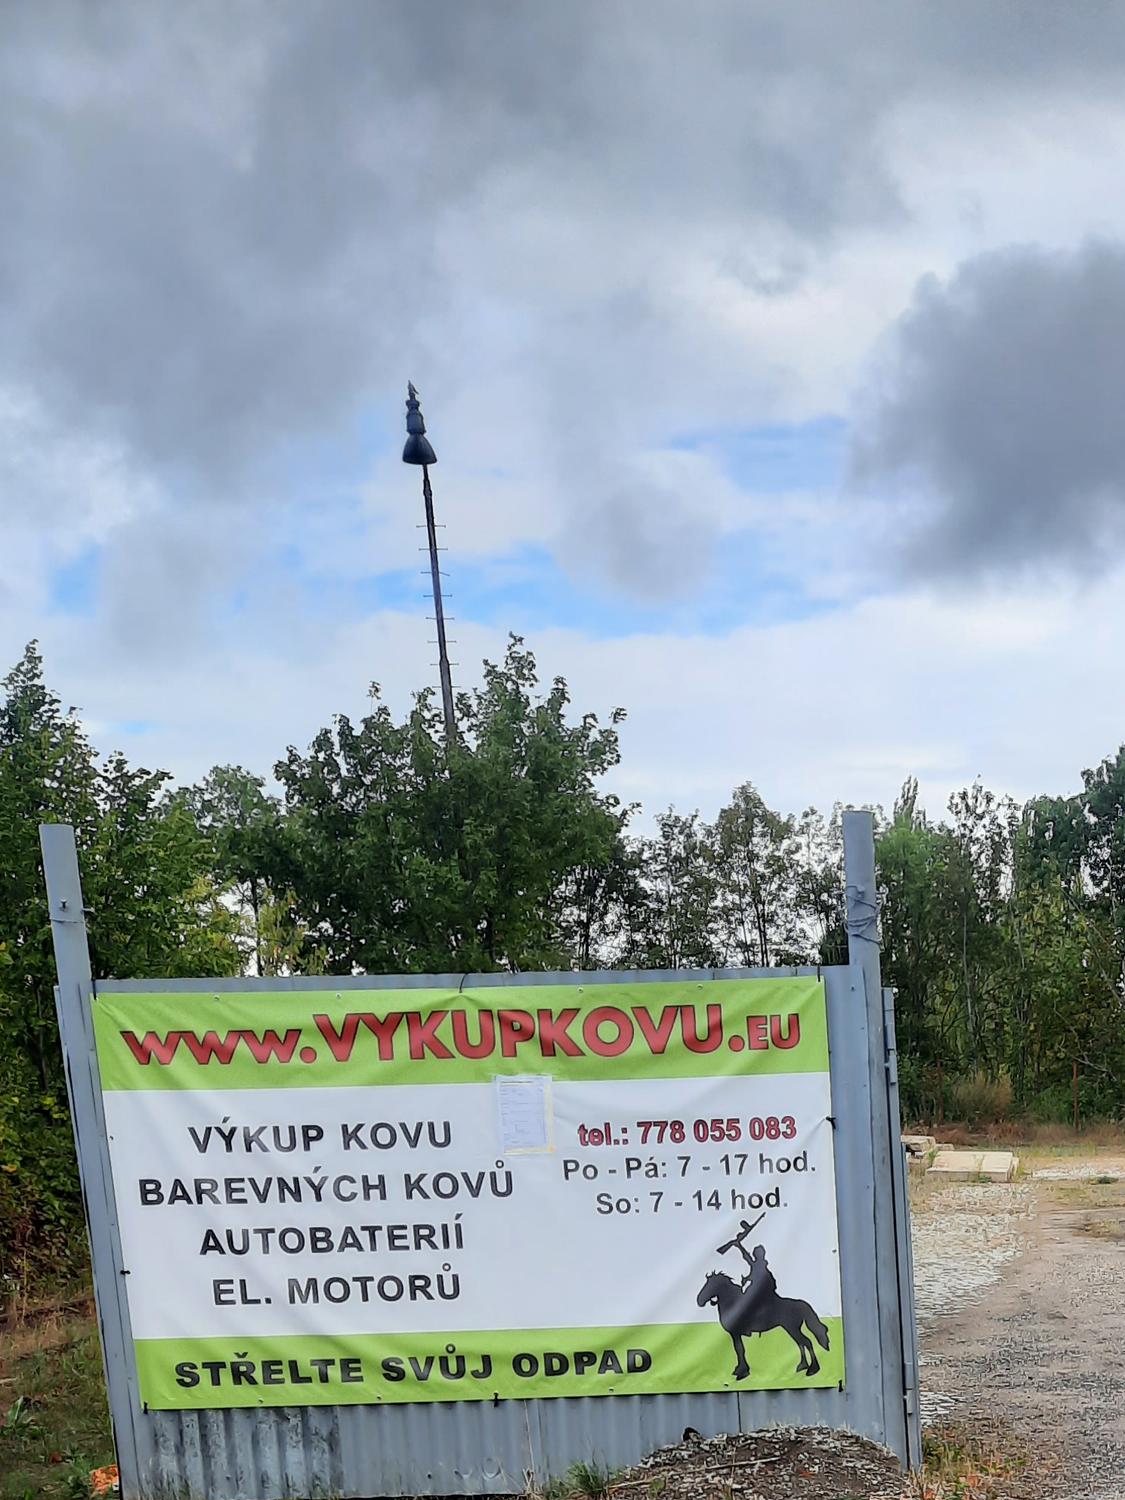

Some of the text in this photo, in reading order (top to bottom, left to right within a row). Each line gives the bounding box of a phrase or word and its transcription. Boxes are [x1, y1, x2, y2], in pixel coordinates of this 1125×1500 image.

[120, 1003, 801, 1065] www.VYKUPKOVU.EU
[188, 1116, 452, 1154] VÝKUP KOVU
[577, 1115, 798, 1147] tel.: 778 055 083
[138, 1160, 514, 1206] BAREVNÝCH KOVŮ
[562, 1159, 598, 1180] Po
[626, 1156, 667, 1179] Pá:
[677, 1156, 692, 1178] 7
[719, 1154, 749, 1176] 17
[758, 1150, 816, 1174] hod.
[596, 1192, 640, 1215] So:
[648, 1191, 664, 1213] 7
[691, 1189, 722, 1211] 14
[730, 1187, 789, 1210] hod.
[199, 1213, 464, 1256] AUTOBATERIÍ
[212, 1262, 461, 1305] EL. MOTORŮ
[175, 1344, 652, 1388] STŘELTE SVŮJ ODPAD
